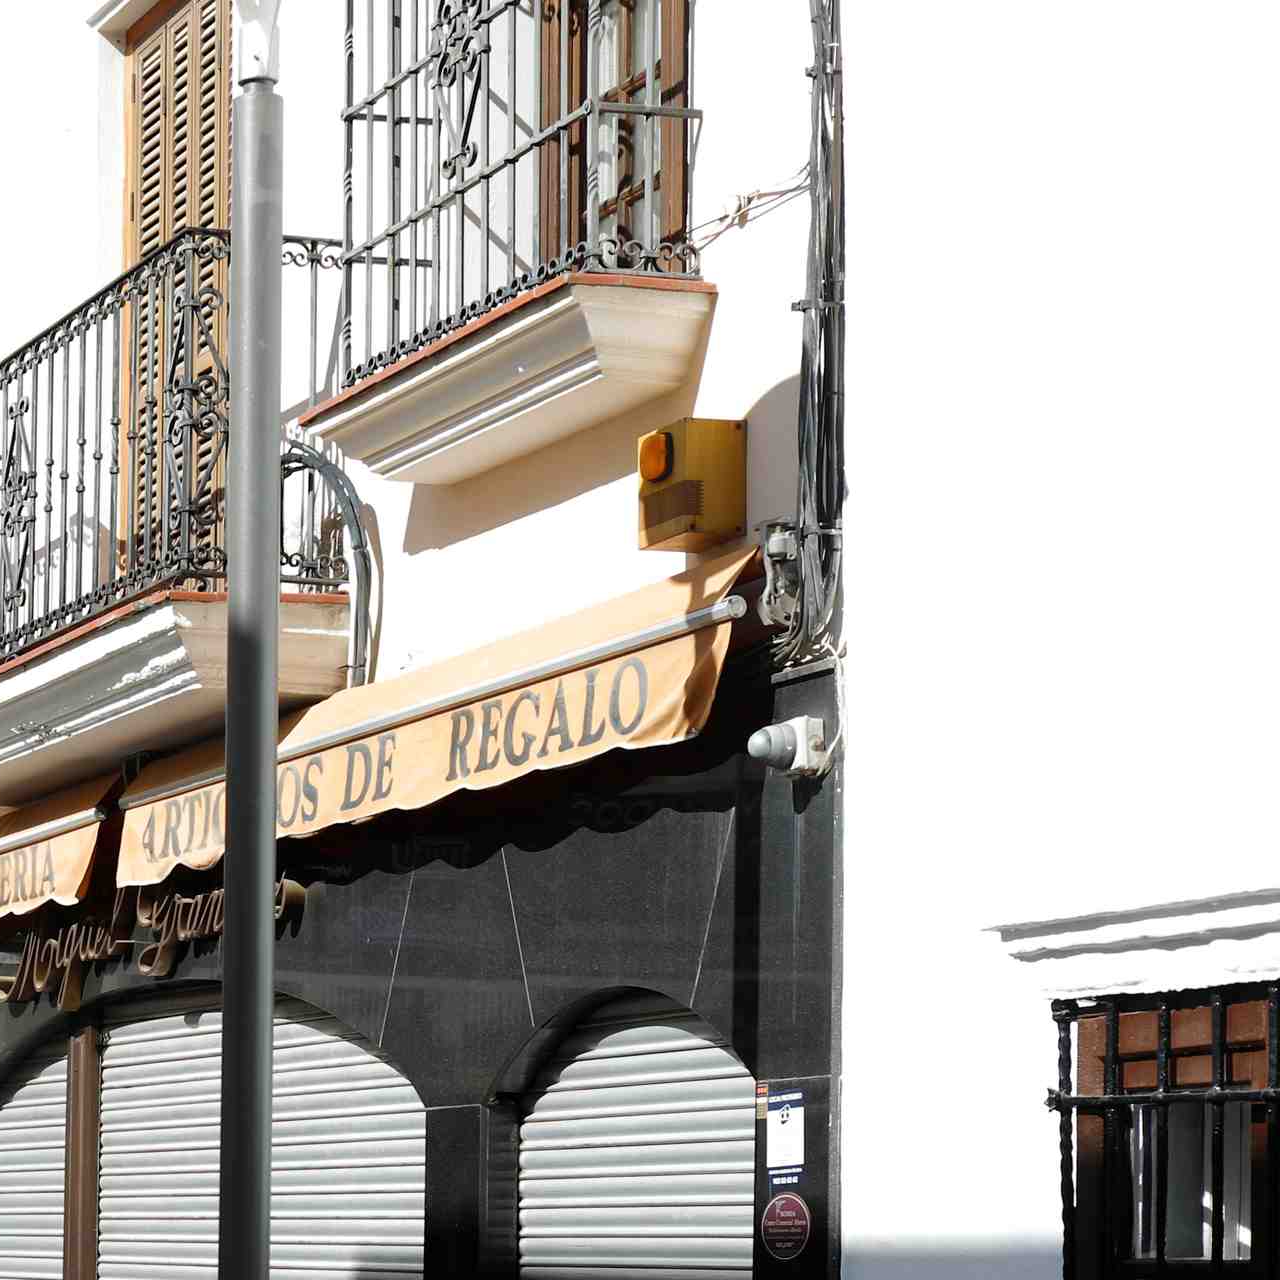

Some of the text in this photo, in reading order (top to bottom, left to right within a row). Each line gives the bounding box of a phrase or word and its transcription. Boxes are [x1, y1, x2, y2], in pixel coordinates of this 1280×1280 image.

[143, 656, 649, 863] ARTICOS DE REGALO
